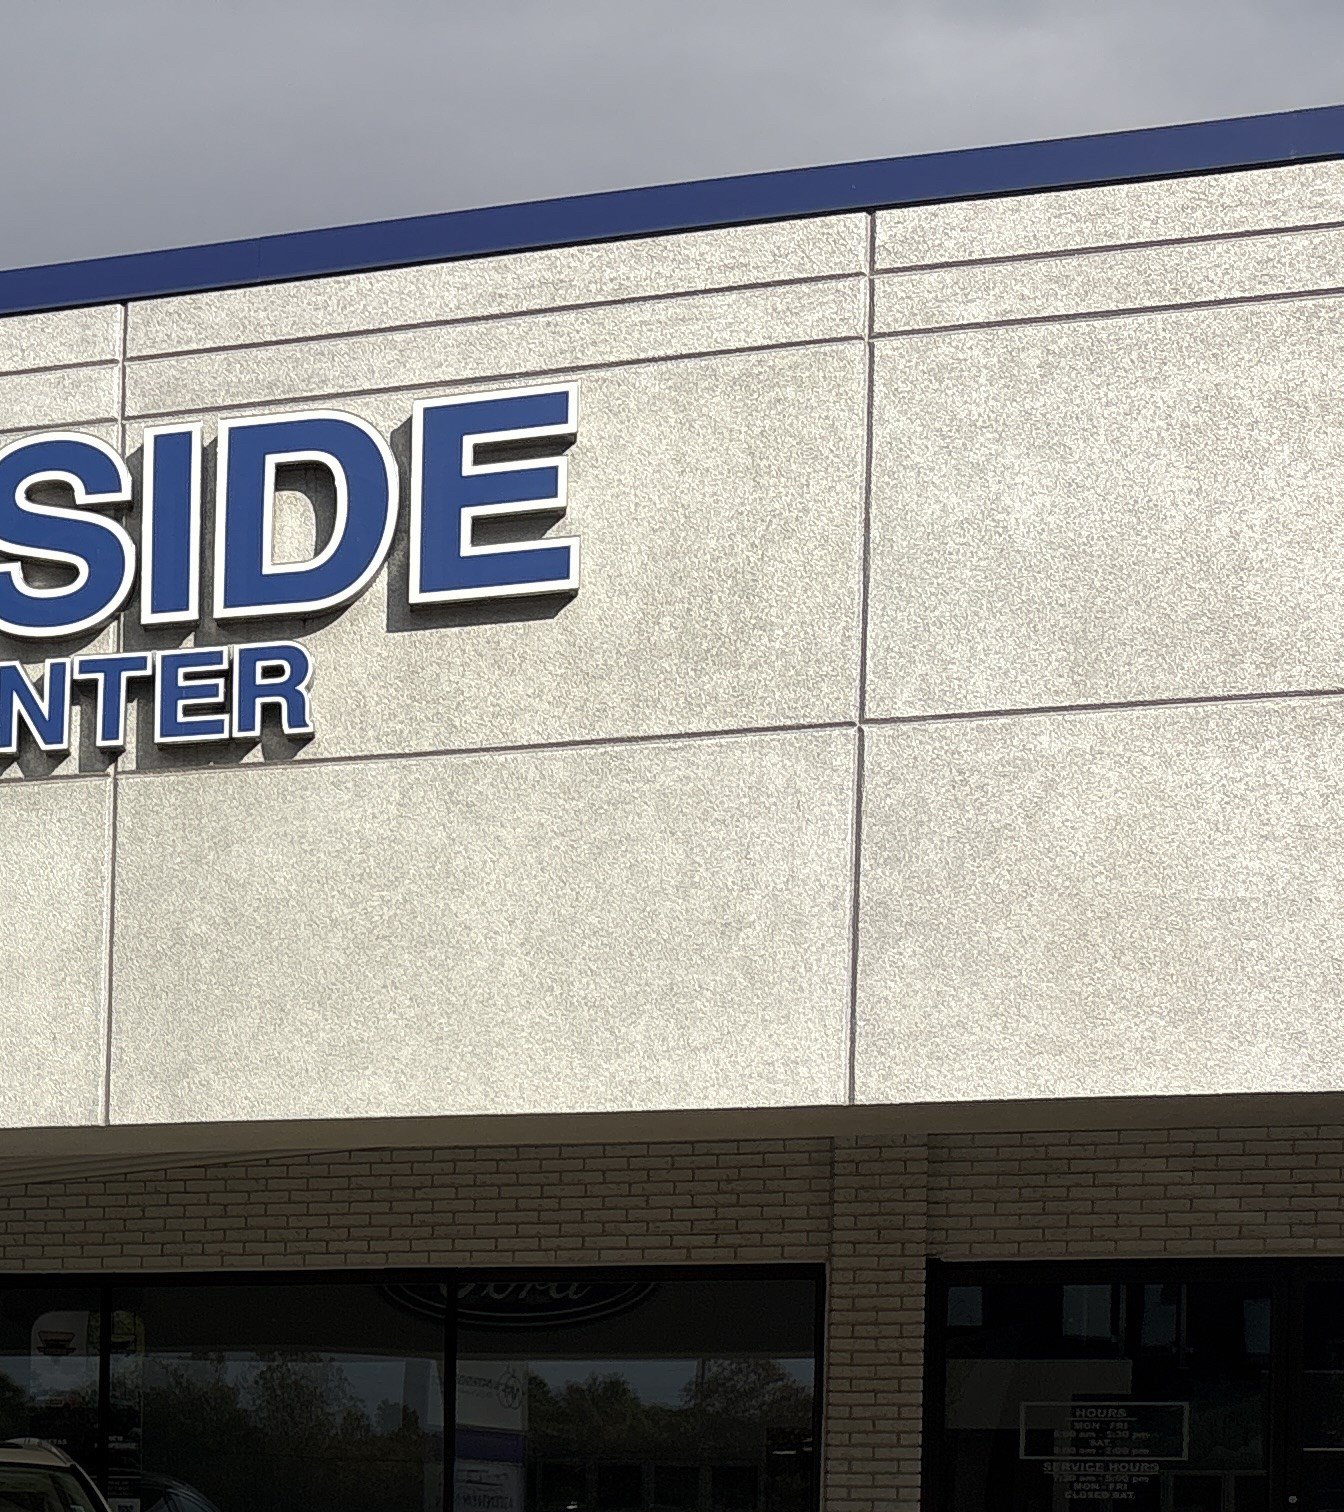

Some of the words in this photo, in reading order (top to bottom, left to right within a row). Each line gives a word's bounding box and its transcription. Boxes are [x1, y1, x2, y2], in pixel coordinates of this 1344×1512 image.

[1075, 1408, 1127, 1418] HOURS
[1043, 1462, 1104, 1472] SERVICE
[1109, 1462, 1159, 1472] HOURS
